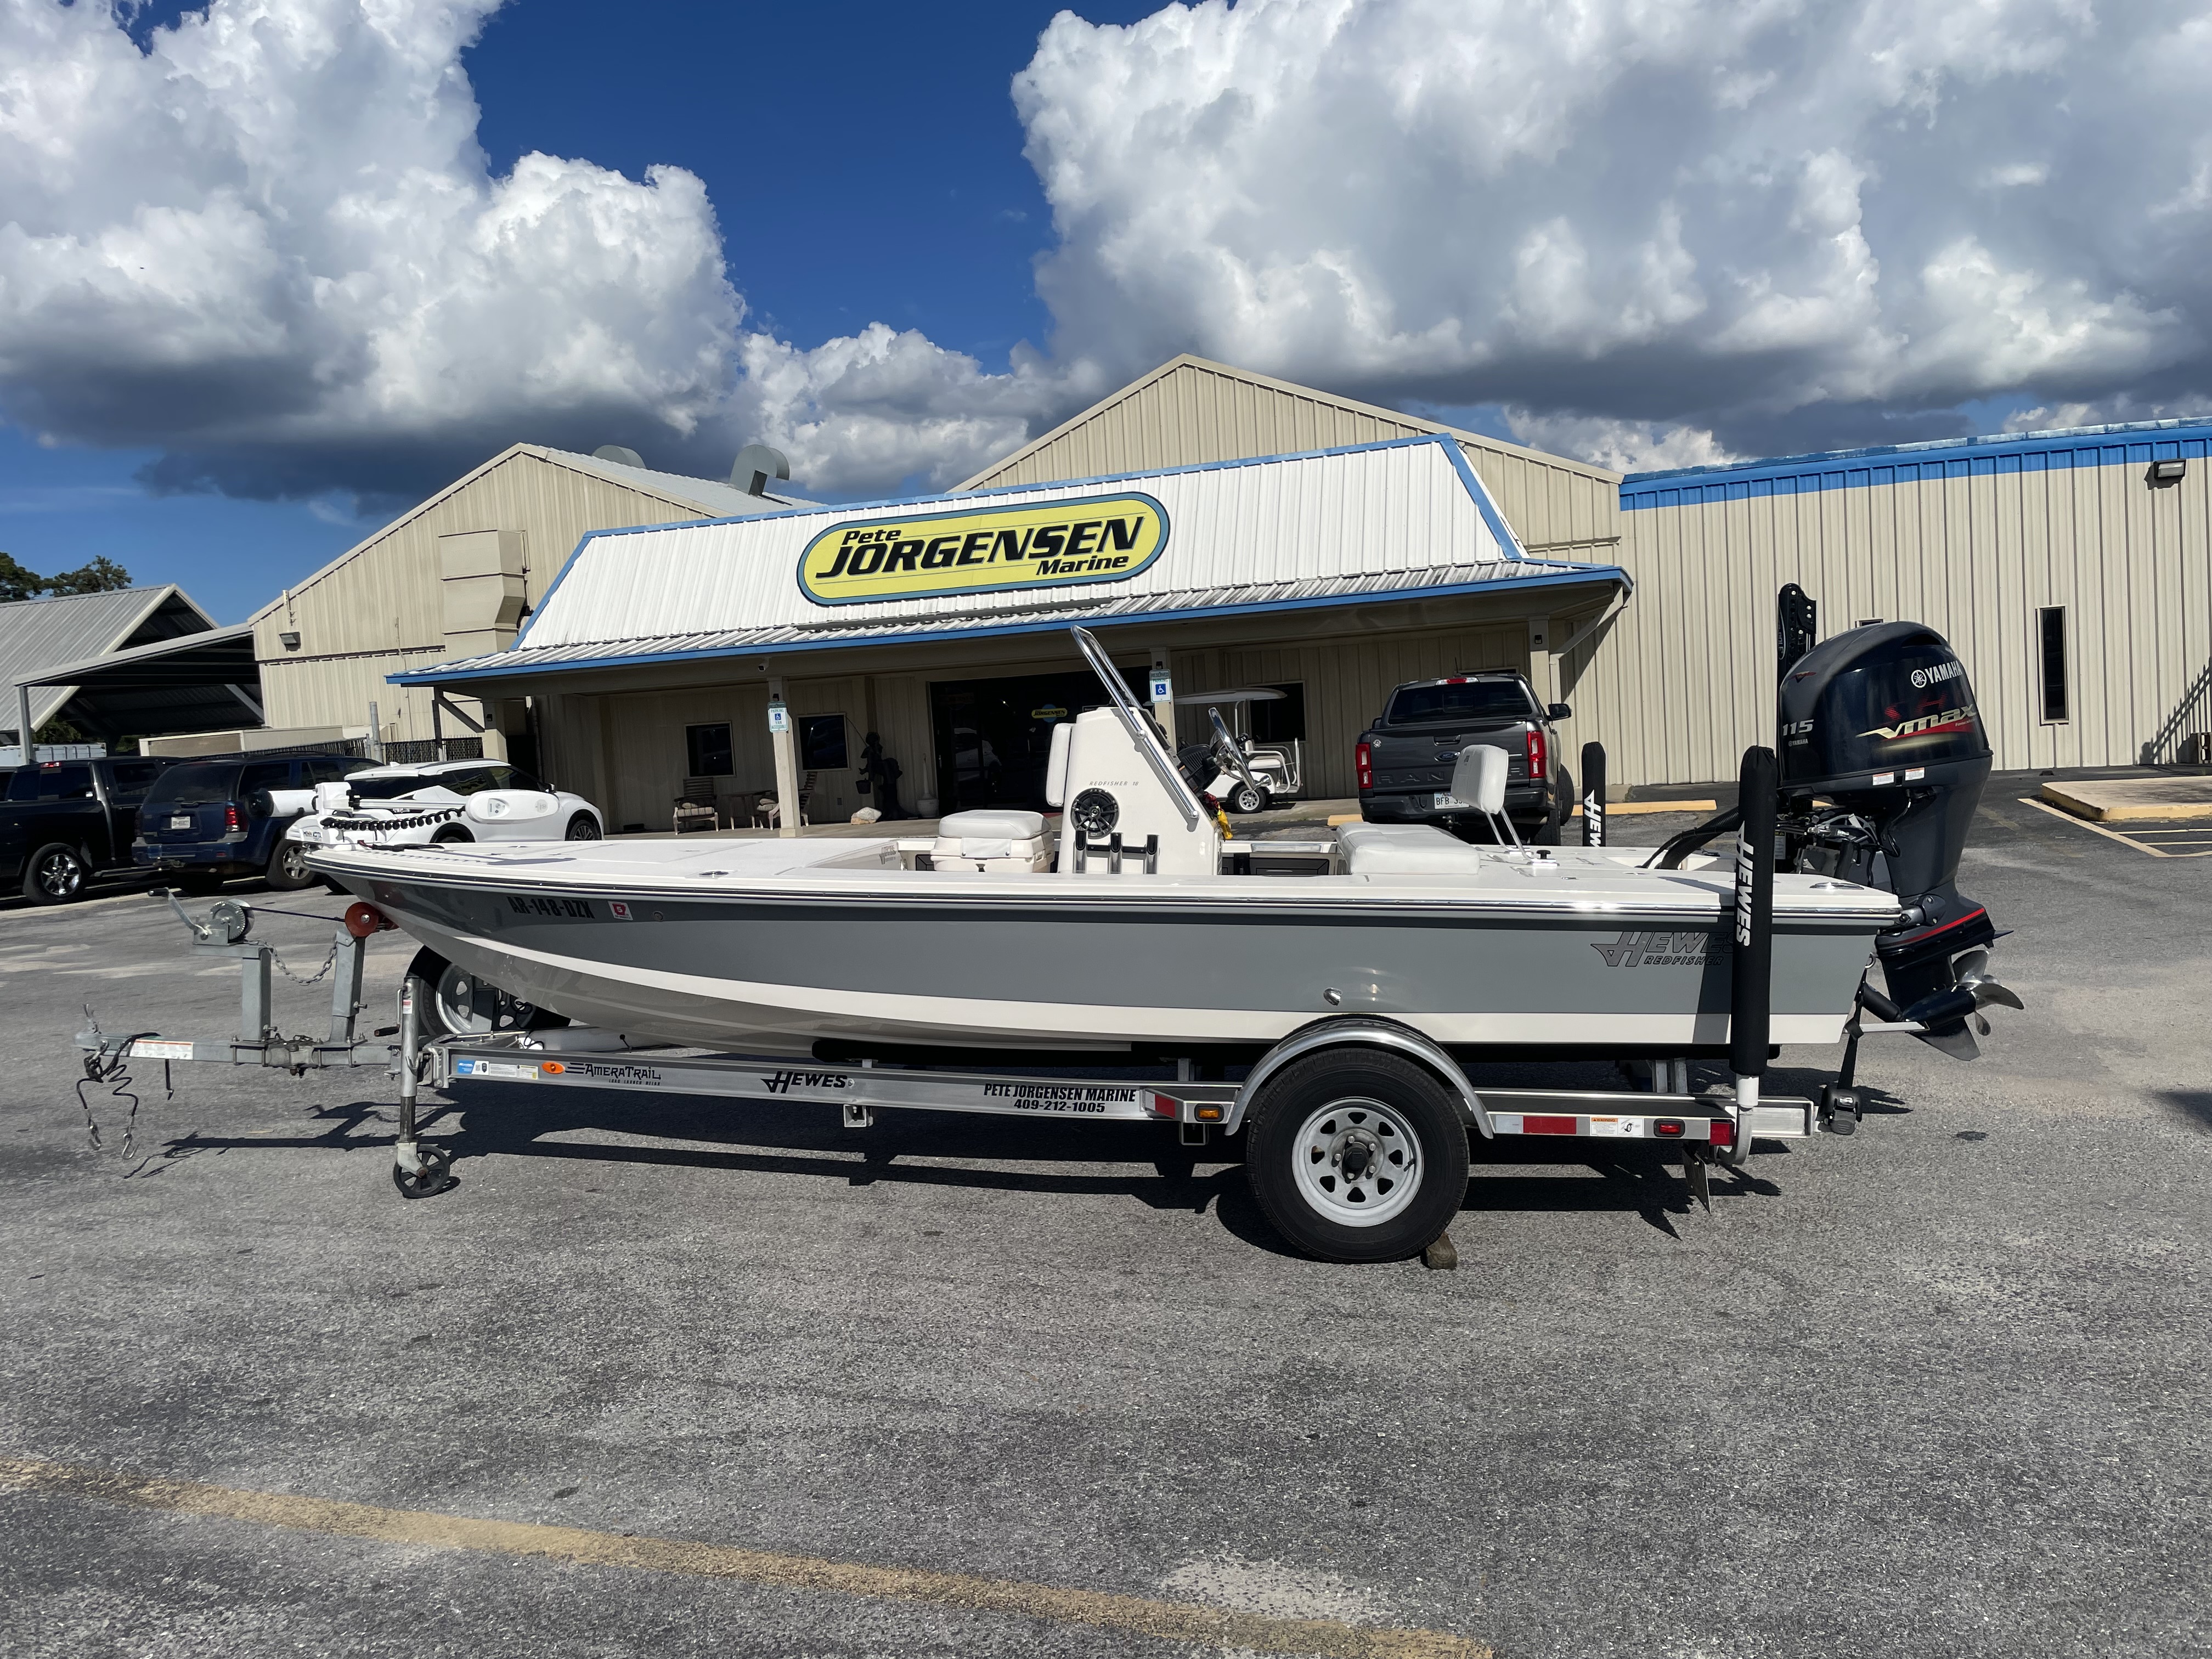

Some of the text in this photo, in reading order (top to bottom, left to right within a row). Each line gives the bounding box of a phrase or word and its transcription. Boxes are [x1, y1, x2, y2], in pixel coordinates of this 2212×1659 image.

[842, 528, 902, 545] Pete
[815, 516, 1145, 579] JORGENSEN
[1035, 554, 1130, 576] Marine
[1926, 660, 1963, 684] YAMAHA
[1782, 719, 1814, 736] 115
[1436, 797, 1449, 805] BFB
[1584, 789, 1601, 848] HEW
[1736, 821, 1754, 947] HEWES
[1644, 955, 1724, 966] REDFISHER
[760, 1071, 848, 1094] HEWES
[984, 1083, 1137, 1102] PETE JORGENSEN MARINE
[1014, 1099, 1105, 1113] 409-212-1005
